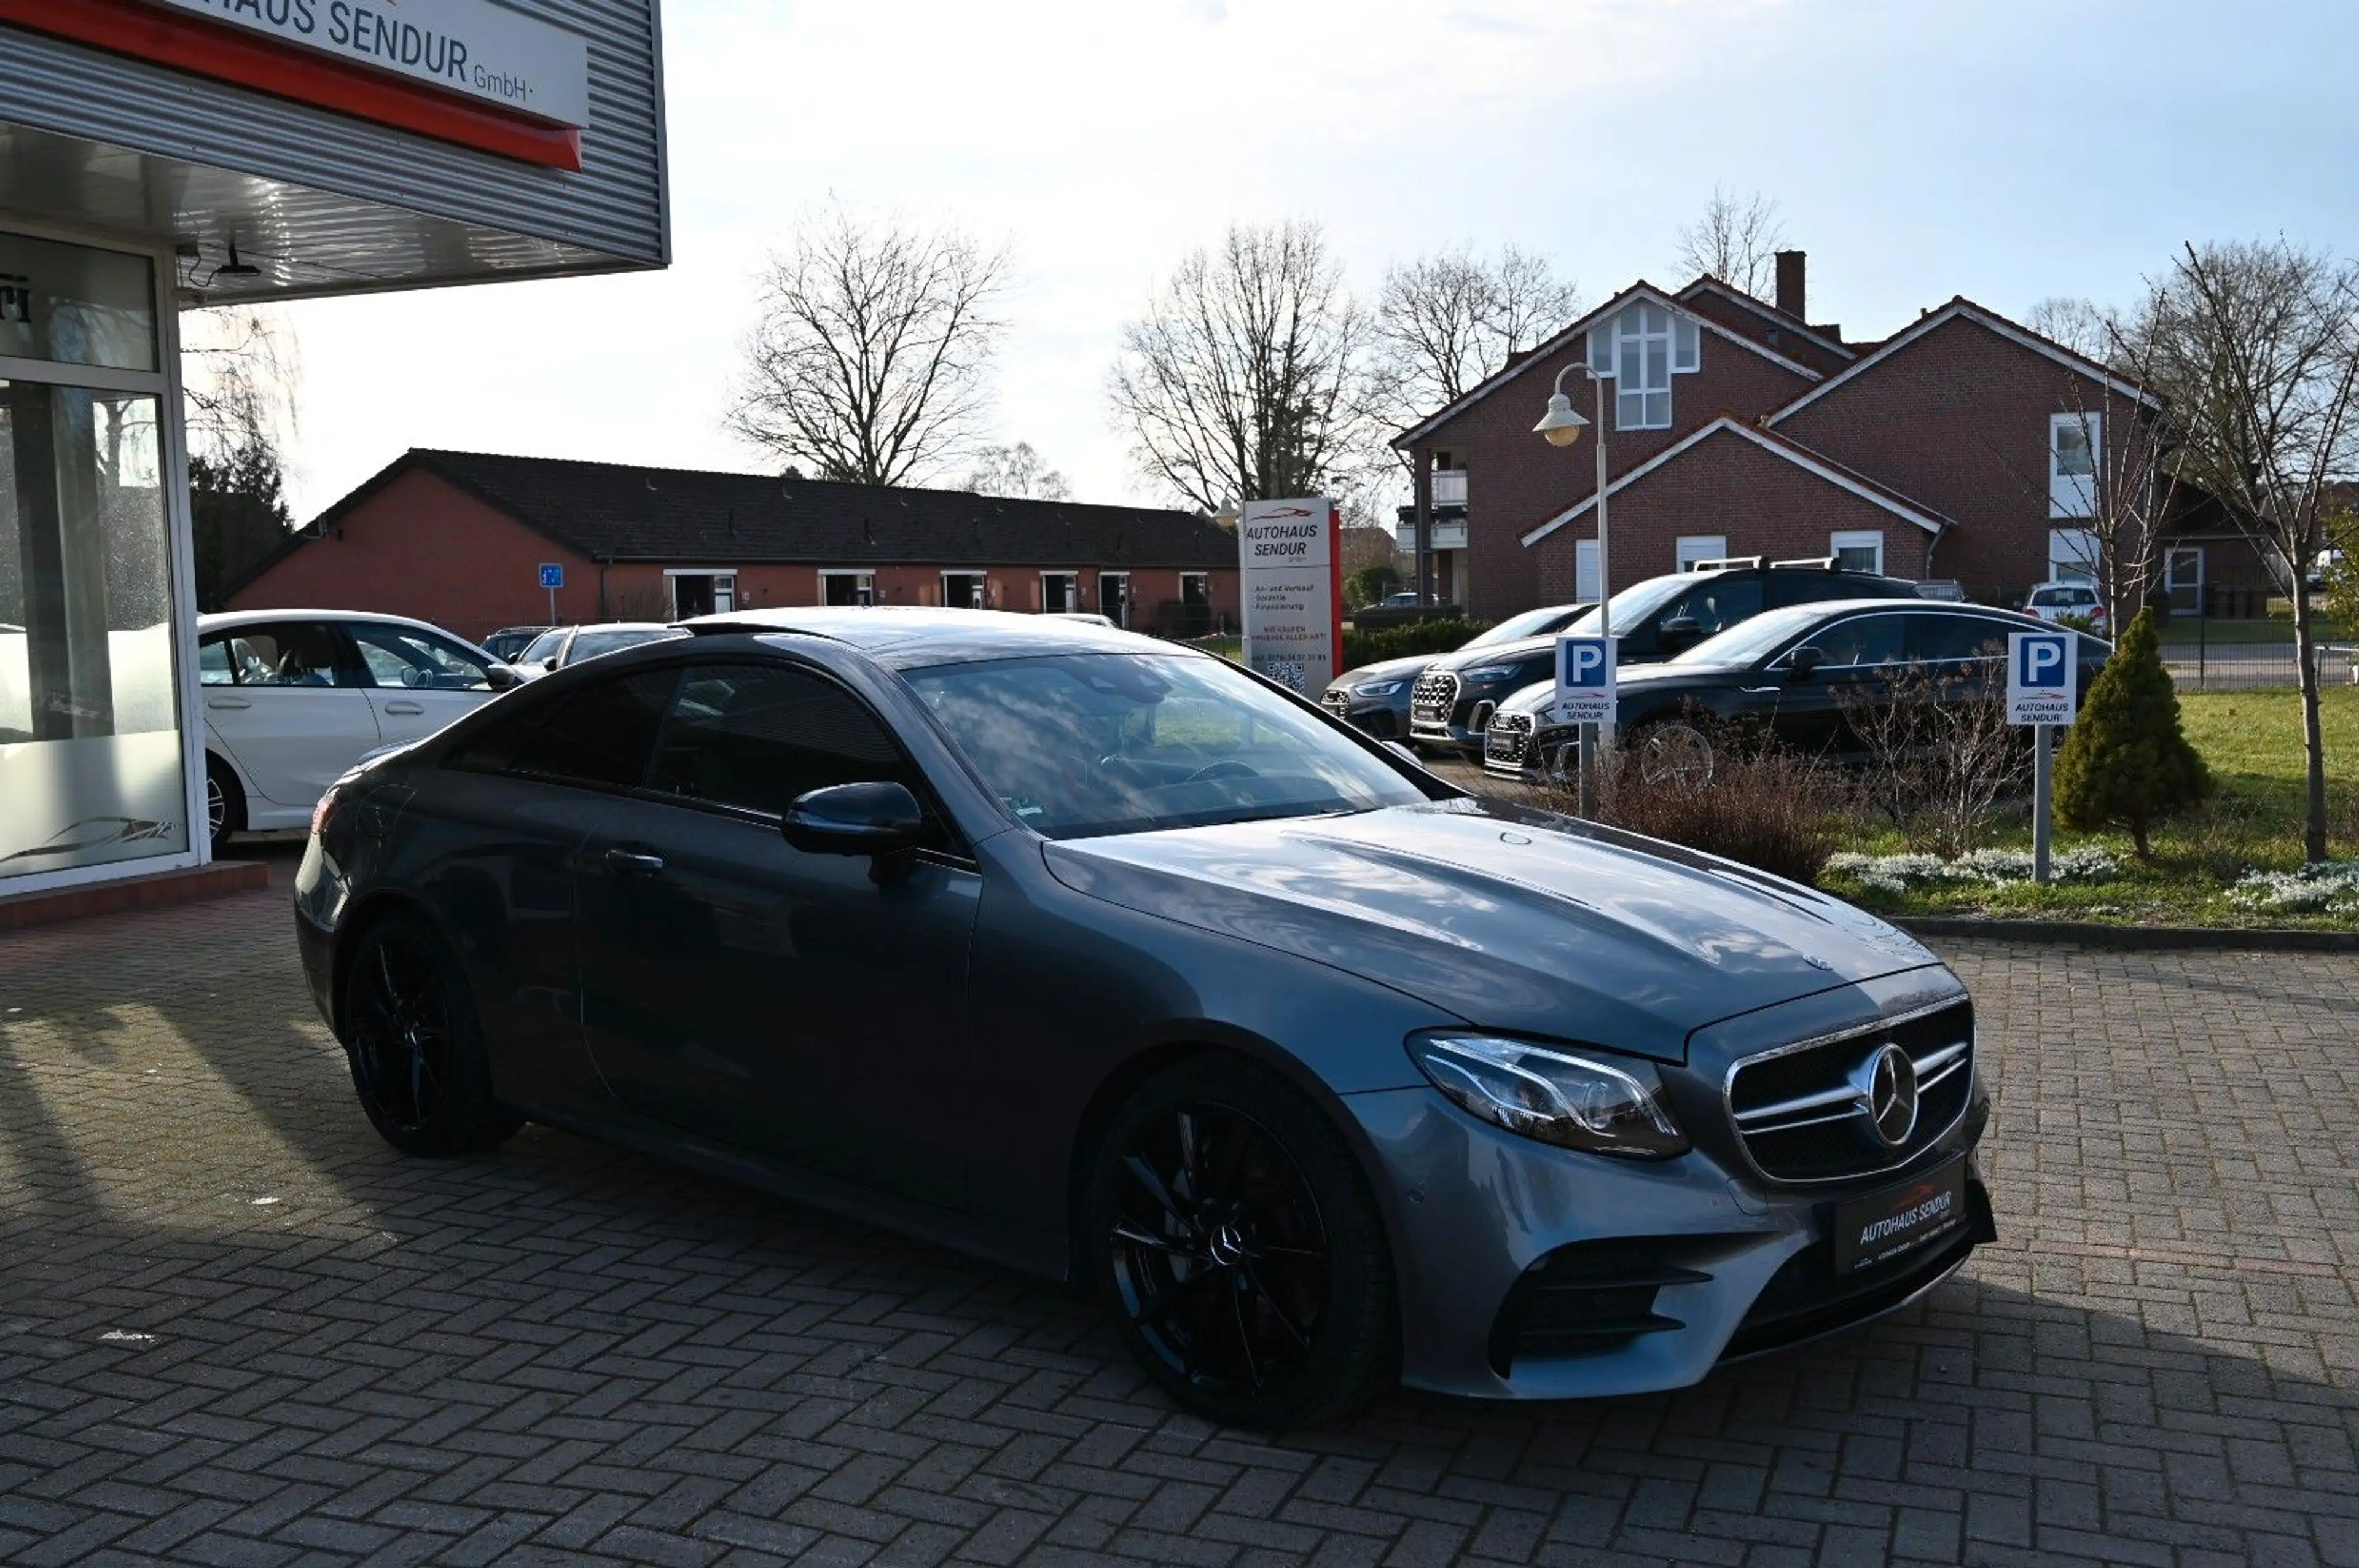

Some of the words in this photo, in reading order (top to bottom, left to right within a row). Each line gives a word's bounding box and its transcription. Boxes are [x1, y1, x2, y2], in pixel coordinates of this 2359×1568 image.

[328, 1, 467, 82] SENDUR
[474, 64, 526, 101] GmbH
[1246, 525, 1318, 540] AUTOHAUS
[1254, 542, 1307, 556] SENDUR
[1573, 646, 1602, 682] P
[2028, 642, 2061, 682] P
[1562, 702, 1610, 711] AUTOHAUS
[2015, 703, 2069, 711] AUTOHAUS
[1566, 712, 1602, 720] SENDUR
[1860, 1207, 1918, 1245] AUTOHAUS
[1919, 1190, 1952, 1221] SENDUR
